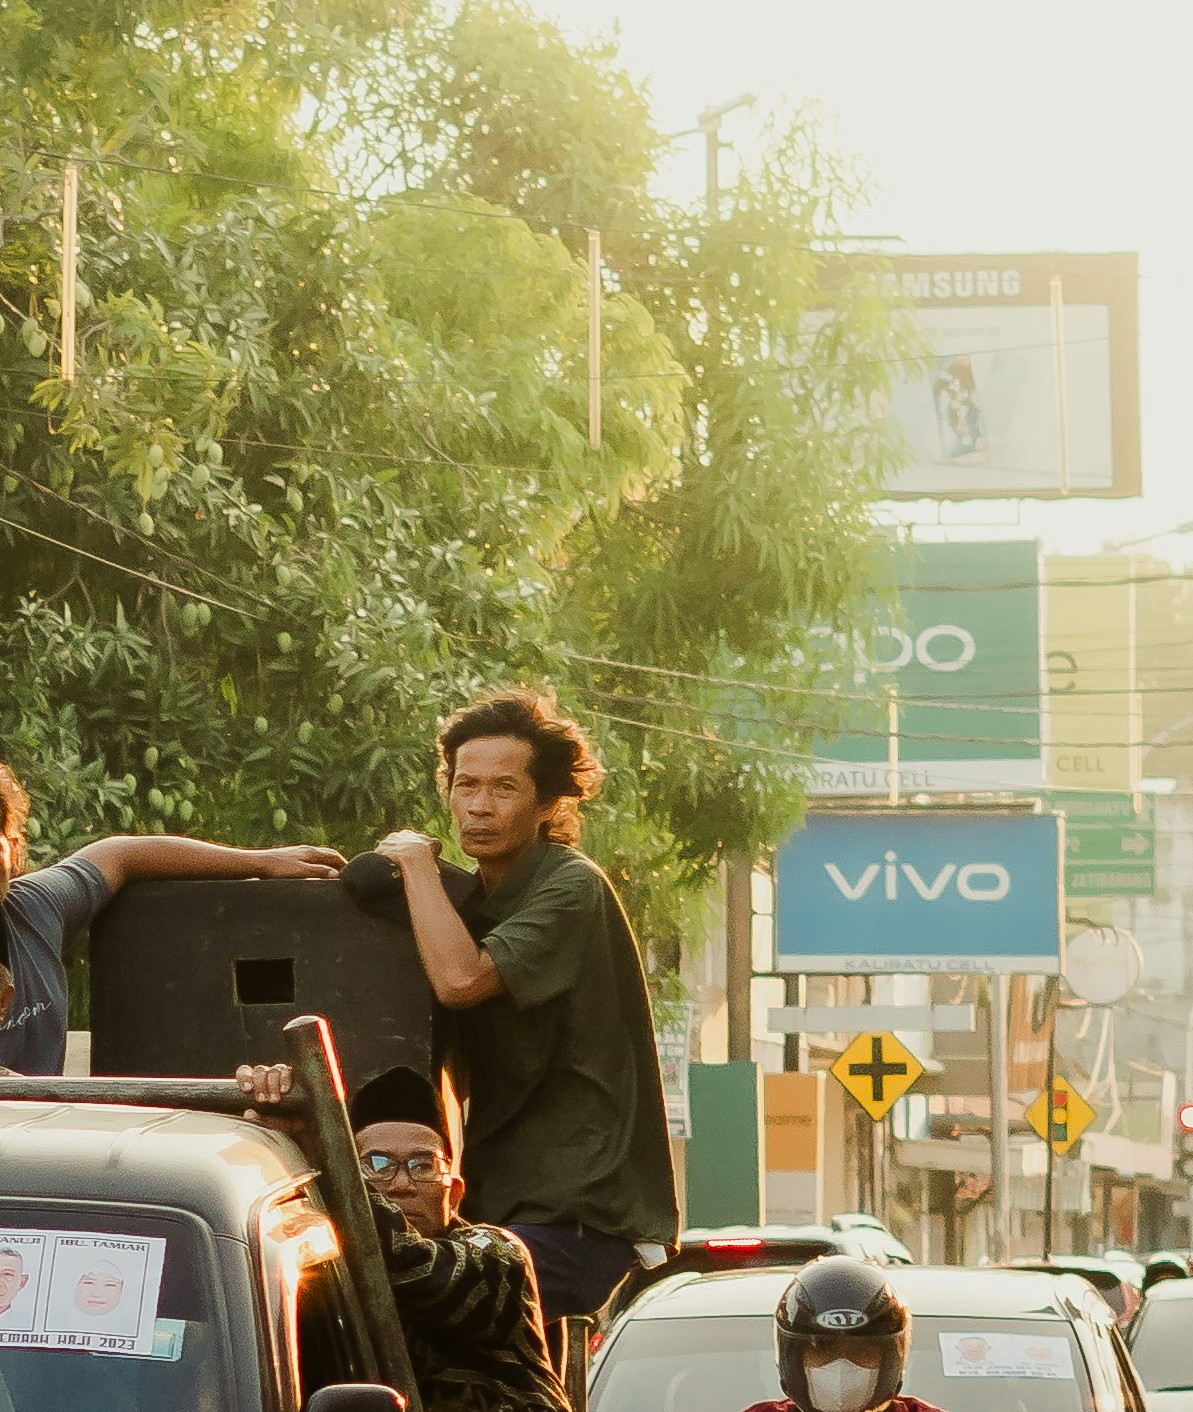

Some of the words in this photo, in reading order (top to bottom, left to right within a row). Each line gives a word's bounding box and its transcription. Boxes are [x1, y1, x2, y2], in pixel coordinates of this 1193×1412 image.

[1055, 755, 1105, 772] CELL
[823, 850, 1011, 901] vivo
[57, 1334, 92, 1347] HAJI
[98, 1337, 136, 1350] 2023
